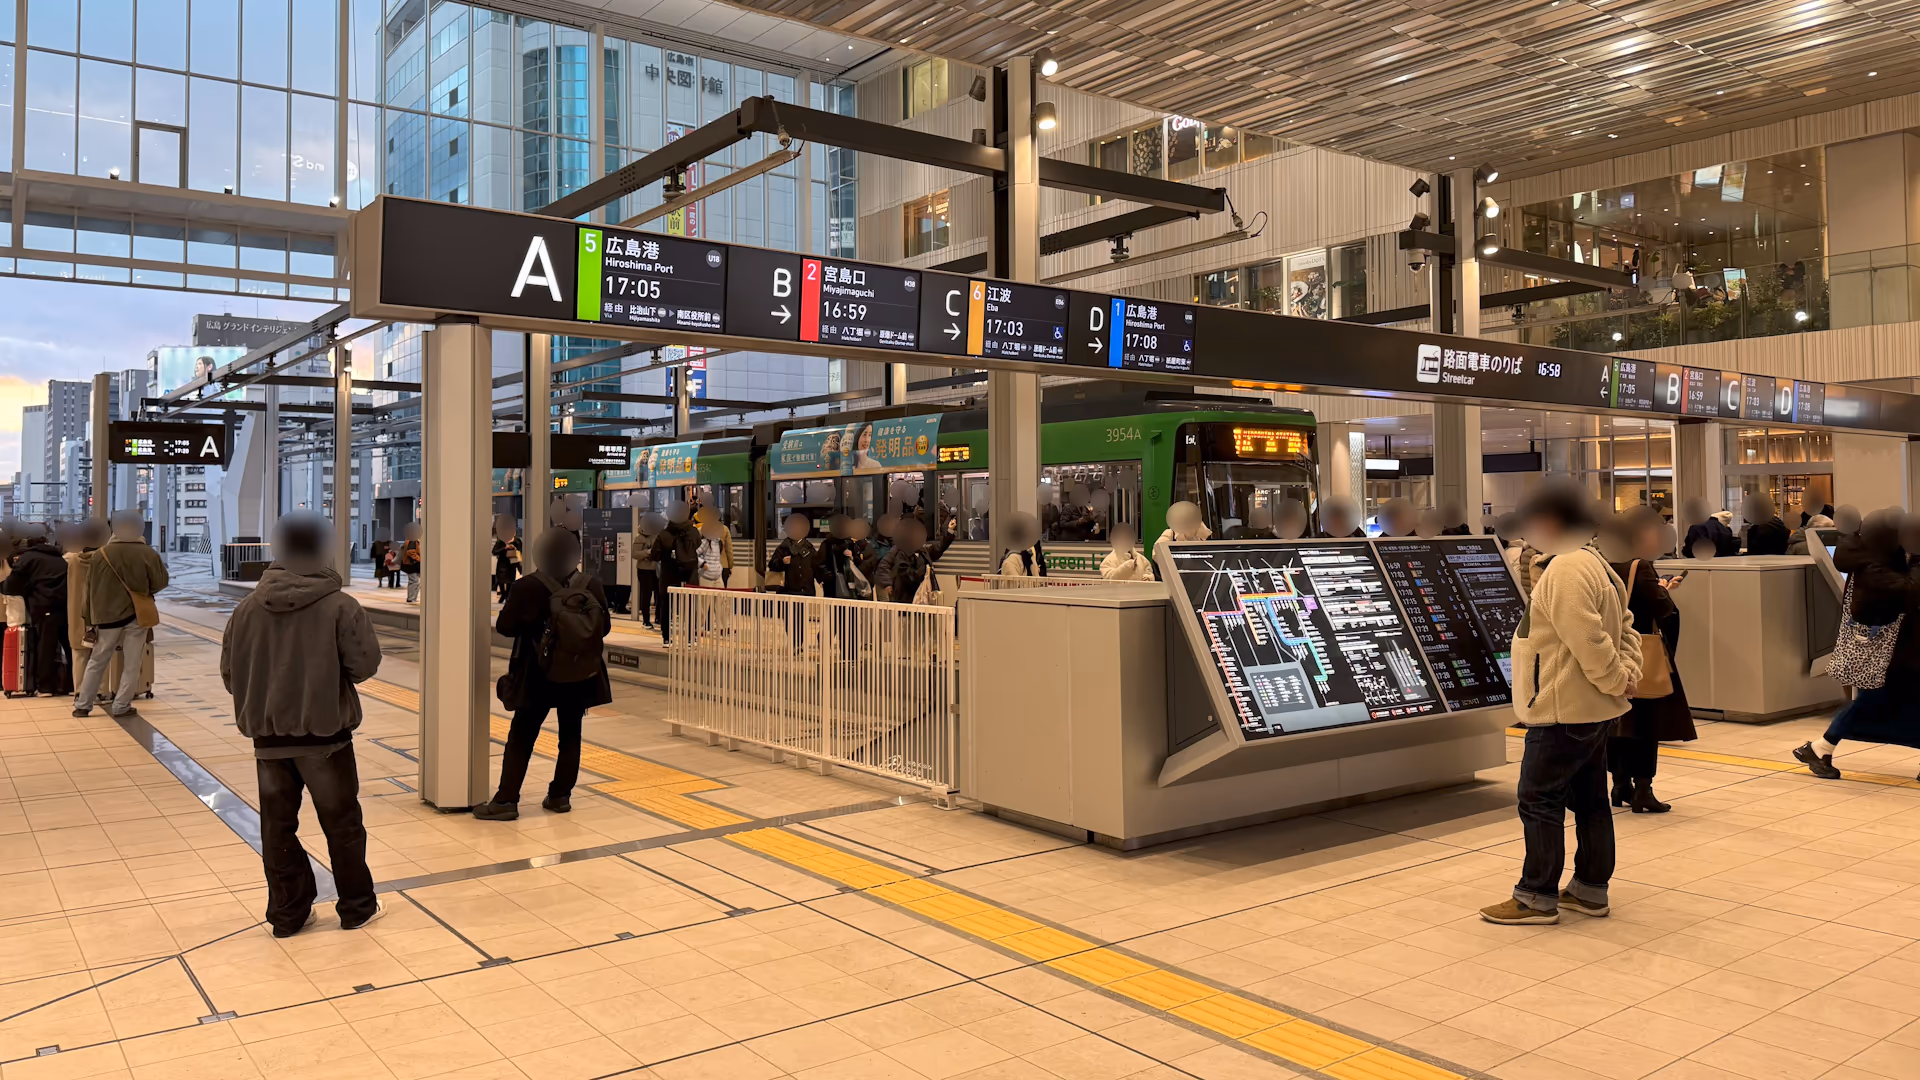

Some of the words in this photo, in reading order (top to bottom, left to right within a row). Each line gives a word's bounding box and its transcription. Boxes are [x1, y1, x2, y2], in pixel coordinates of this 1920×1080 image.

[668, 52, 694, 66] 広島市
[585, 233, 597, 253] 5
[605, 236, 660, 260] 広島港
[605, 257, 652, 271] Hiroshima
[654, 263, 674, 274] Port
[708, 254, 720, 263] U18
[511, 236, 563, 302] A
[807, 263, 817, 281] 2
[824, 265, 866, 286] 宮島口
[606, 276, 661, 299] 17:05
[773, 267, 792, 298] B
[823, 284, 875, 298] Miyajimaguchi
[973, 285, 982, 300] 6
[987, 286, 1012, 303] 江波
[604, 302, 623, 313] 経由
[629, 305, 657, 316] 比治山下
[676, 309, 712, 322] 南区役所前
[823, 300, 867, 321] 16:59
[945, 290, 961, 317] C
[986, 303, 999, 312] Eba
[1115, 302, 1120, 316] 1
[1126, 304, 1158, 320] 広島港
[1089, 306, 1104, 331] D
[1125, 319, 1153, 330] Hiroshima
[1153, 322, 1165, 331] Port
[986, 319, 1024, 337] 17:03
[1125, 333, 1158, 350] 17:08
[1442, 348, 1524, 375] 路面電車のりば
[1537, 362, 1562, 378] 16:58
[1614, 361, 1619, 372] 5
[1442, 371, 1476, 385] Streetcar
[1601, 365, 1610, 383] A
[1619, 383, 1636, 395] 17:05
[1666, 372, 1680, 405] B
[1727, 380, 1739, 410] C
[1780, 386, 1792, 415] D
[1106, 427, 1142, 443] 3954A
[199, 435, 220, 458] A
[876, 436, 915, 459] 発明品
[1043, 552, 1086, 570] Green
